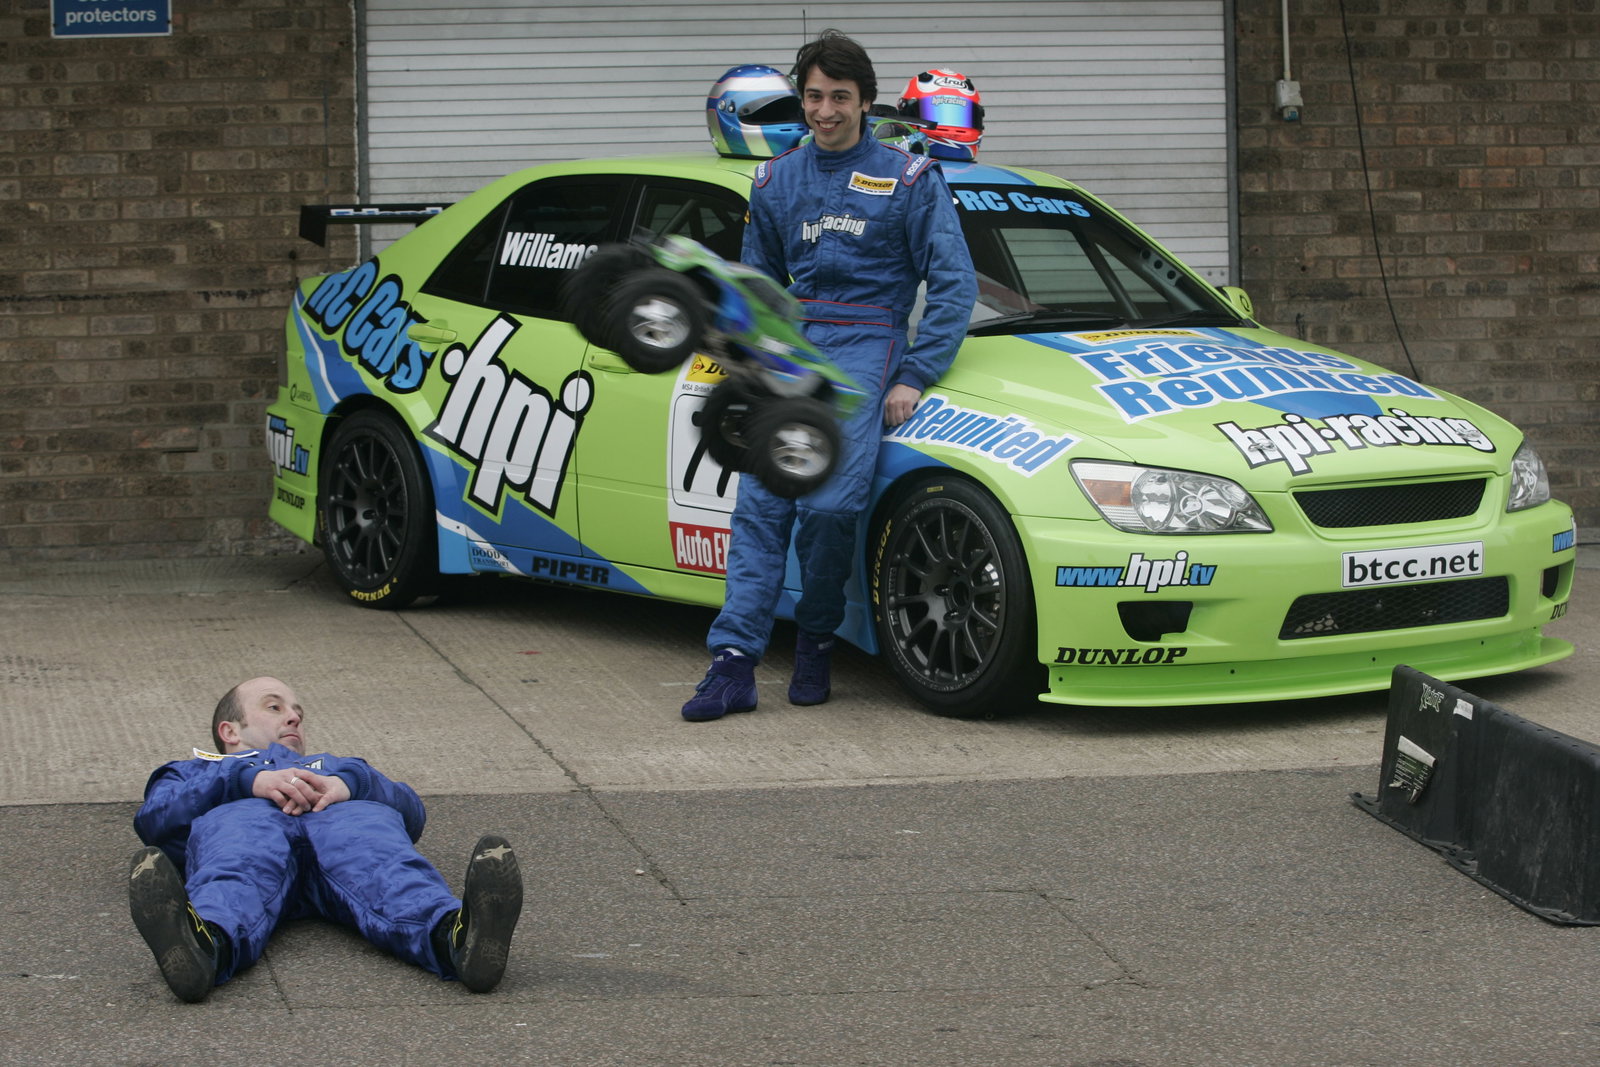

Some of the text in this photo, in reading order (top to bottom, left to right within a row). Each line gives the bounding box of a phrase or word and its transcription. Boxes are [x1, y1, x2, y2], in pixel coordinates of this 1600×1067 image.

[65, 7, 157, 26] protectors
[954, 190, 1091, 217] RC Cars
[306, 258, 434, 391] RC Cars
[1083, 343, 1354, 381] Friends
[1098, 364, 1435, 421] Reunited
[894, 396, 1075, 473] Reunited
[676, 528, 713, 568] Auto
[873, 519, 892, 605] DUNLOP
[1349, 549, 1479, 583] btcc.net
[532, 556, 609, 584] PIPER
[1056, 551, 1217, 593] www.hpi.tv
[351, 583, 391, 601] DUNLOP
[1054, 646, 1188, 665] DUNLOP
